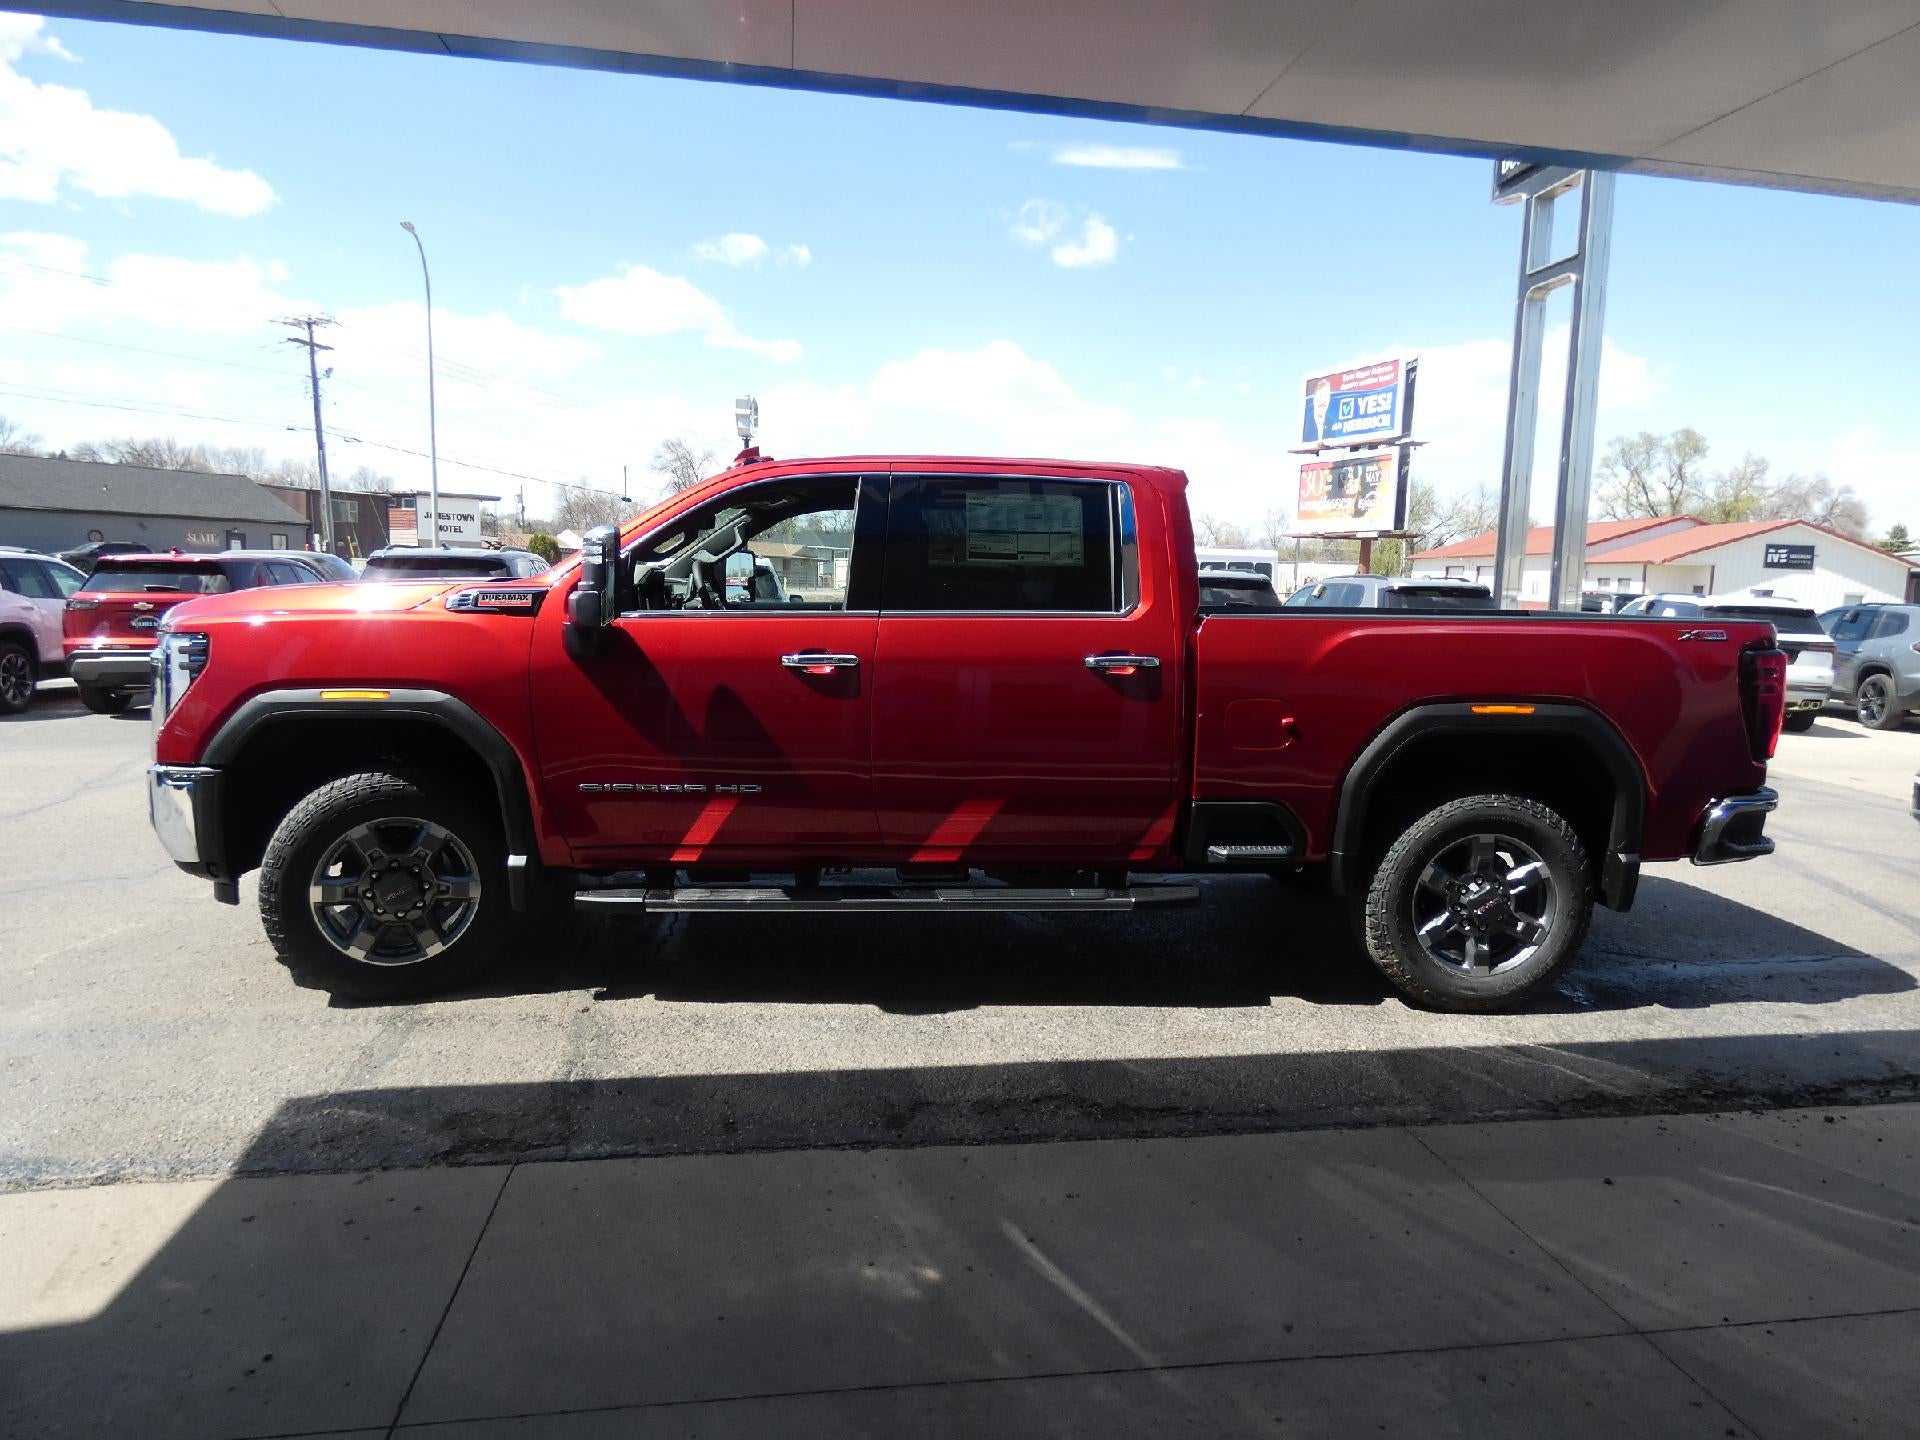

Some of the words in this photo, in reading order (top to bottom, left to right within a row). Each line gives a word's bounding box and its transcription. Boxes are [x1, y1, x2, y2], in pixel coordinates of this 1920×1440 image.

[1357, 391, 1393, 415] YES!
[579, 783, 706, 793] SIERRA
[715, 783, 762, 793] HD
